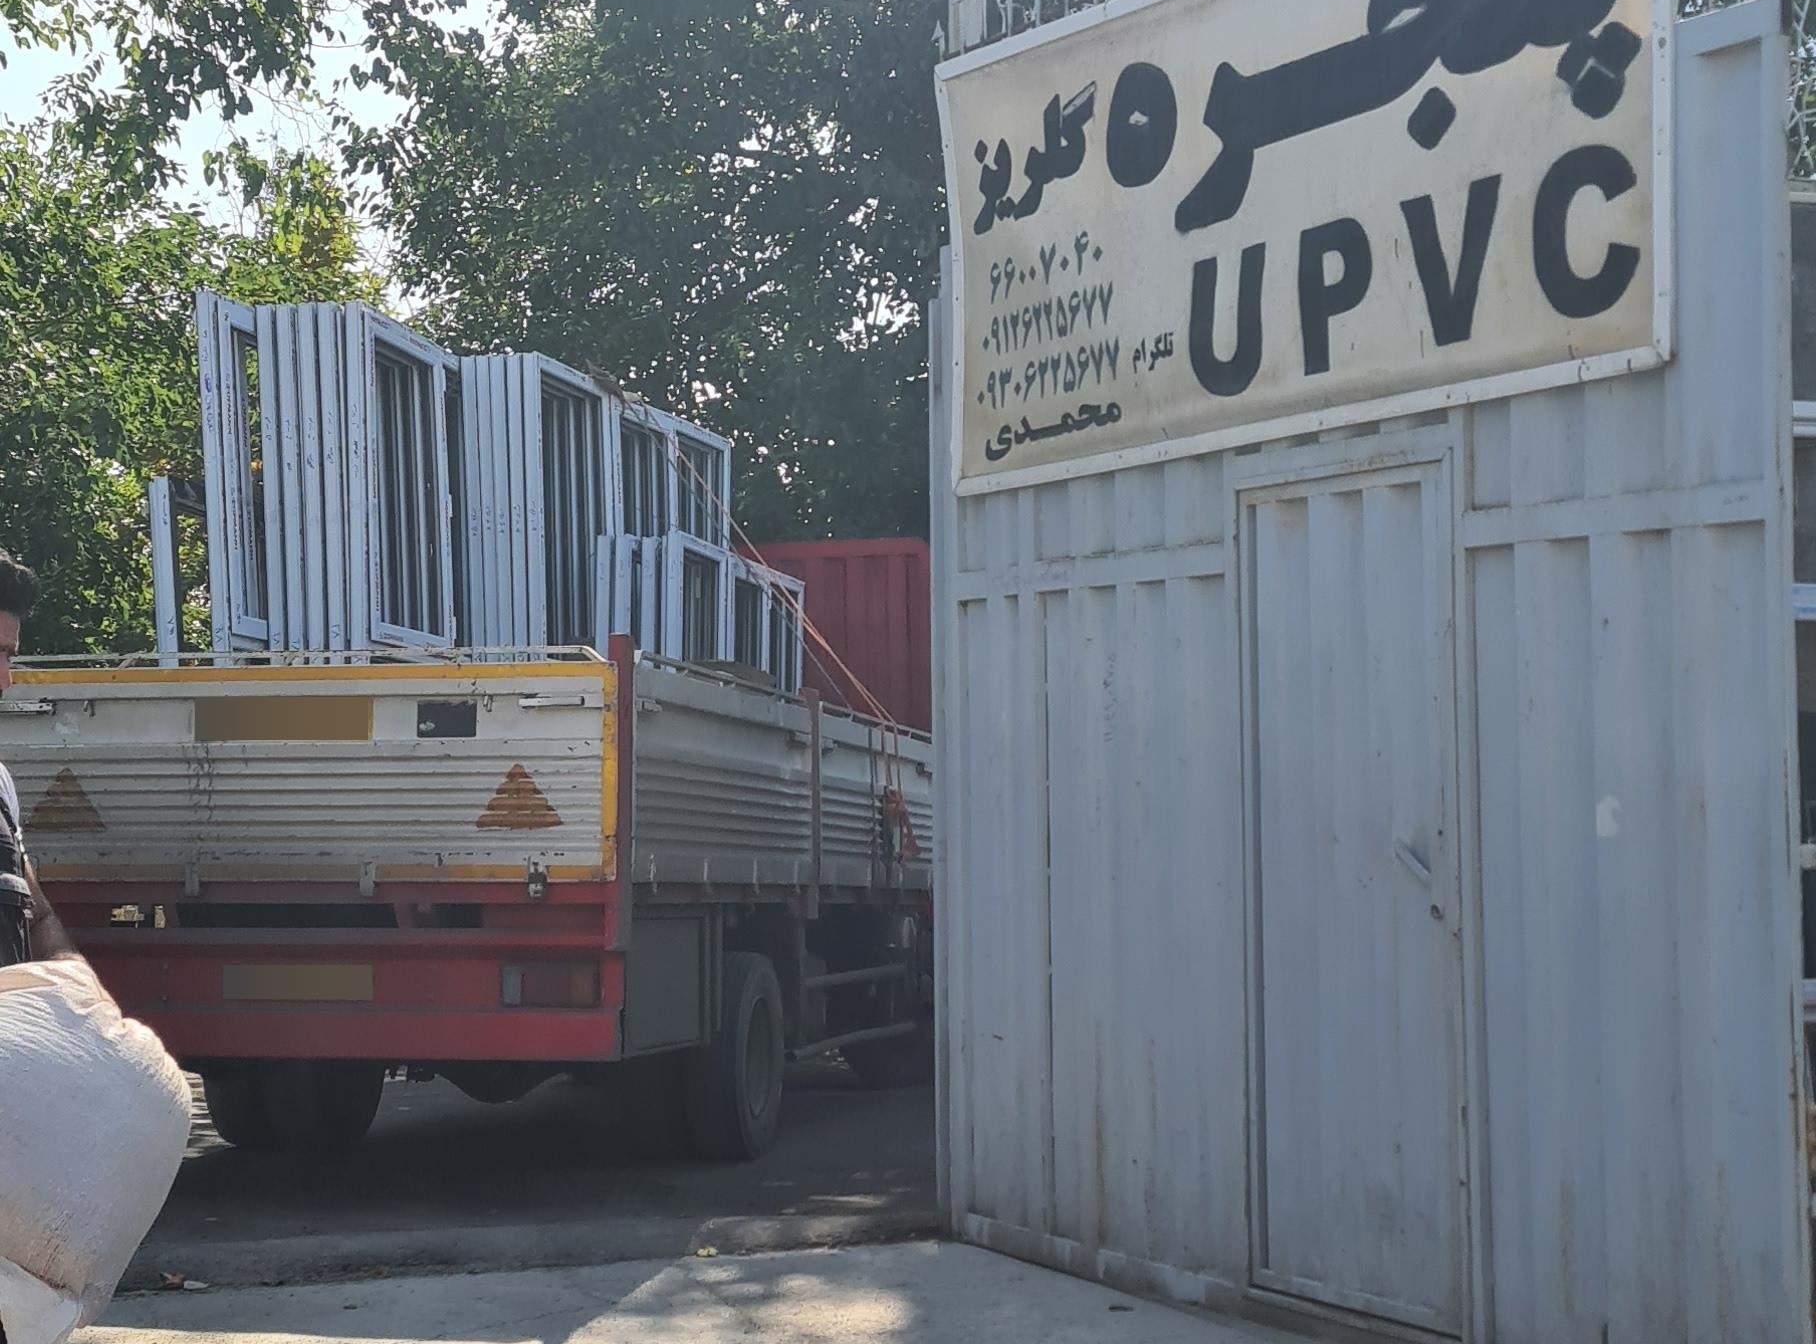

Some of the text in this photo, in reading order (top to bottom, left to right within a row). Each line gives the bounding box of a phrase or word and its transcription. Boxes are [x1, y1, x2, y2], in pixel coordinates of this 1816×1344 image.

[974, 80, 1097, 236] گلریز
[990, 231, 1103, 304] ۶۶۰۰۷۰۴۰
[1189, 145, 1641, 397] UPVC
[1132, 332, 1174, 374] تلگرام
[985, 401, 1122, 461] محمدی
